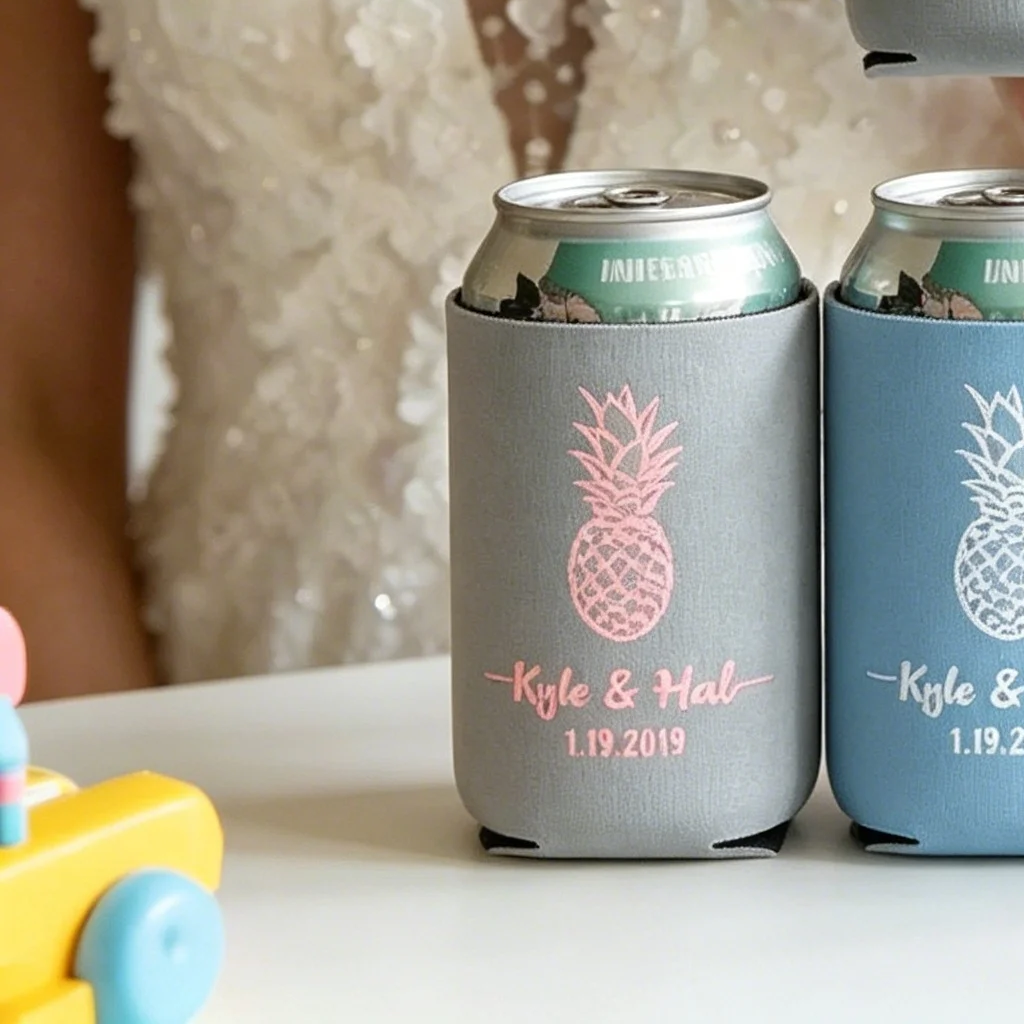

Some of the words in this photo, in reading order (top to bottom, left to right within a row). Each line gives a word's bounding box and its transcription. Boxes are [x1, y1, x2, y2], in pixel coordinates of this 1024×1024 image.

[511, 660, 592, 721] Kyle
[602, 668, 639, 710] &
[653, 659, 774, 712] Hal
[899, 660, 976, 718] Kyle
[564, 727, 687, 758] 1.19.2019
